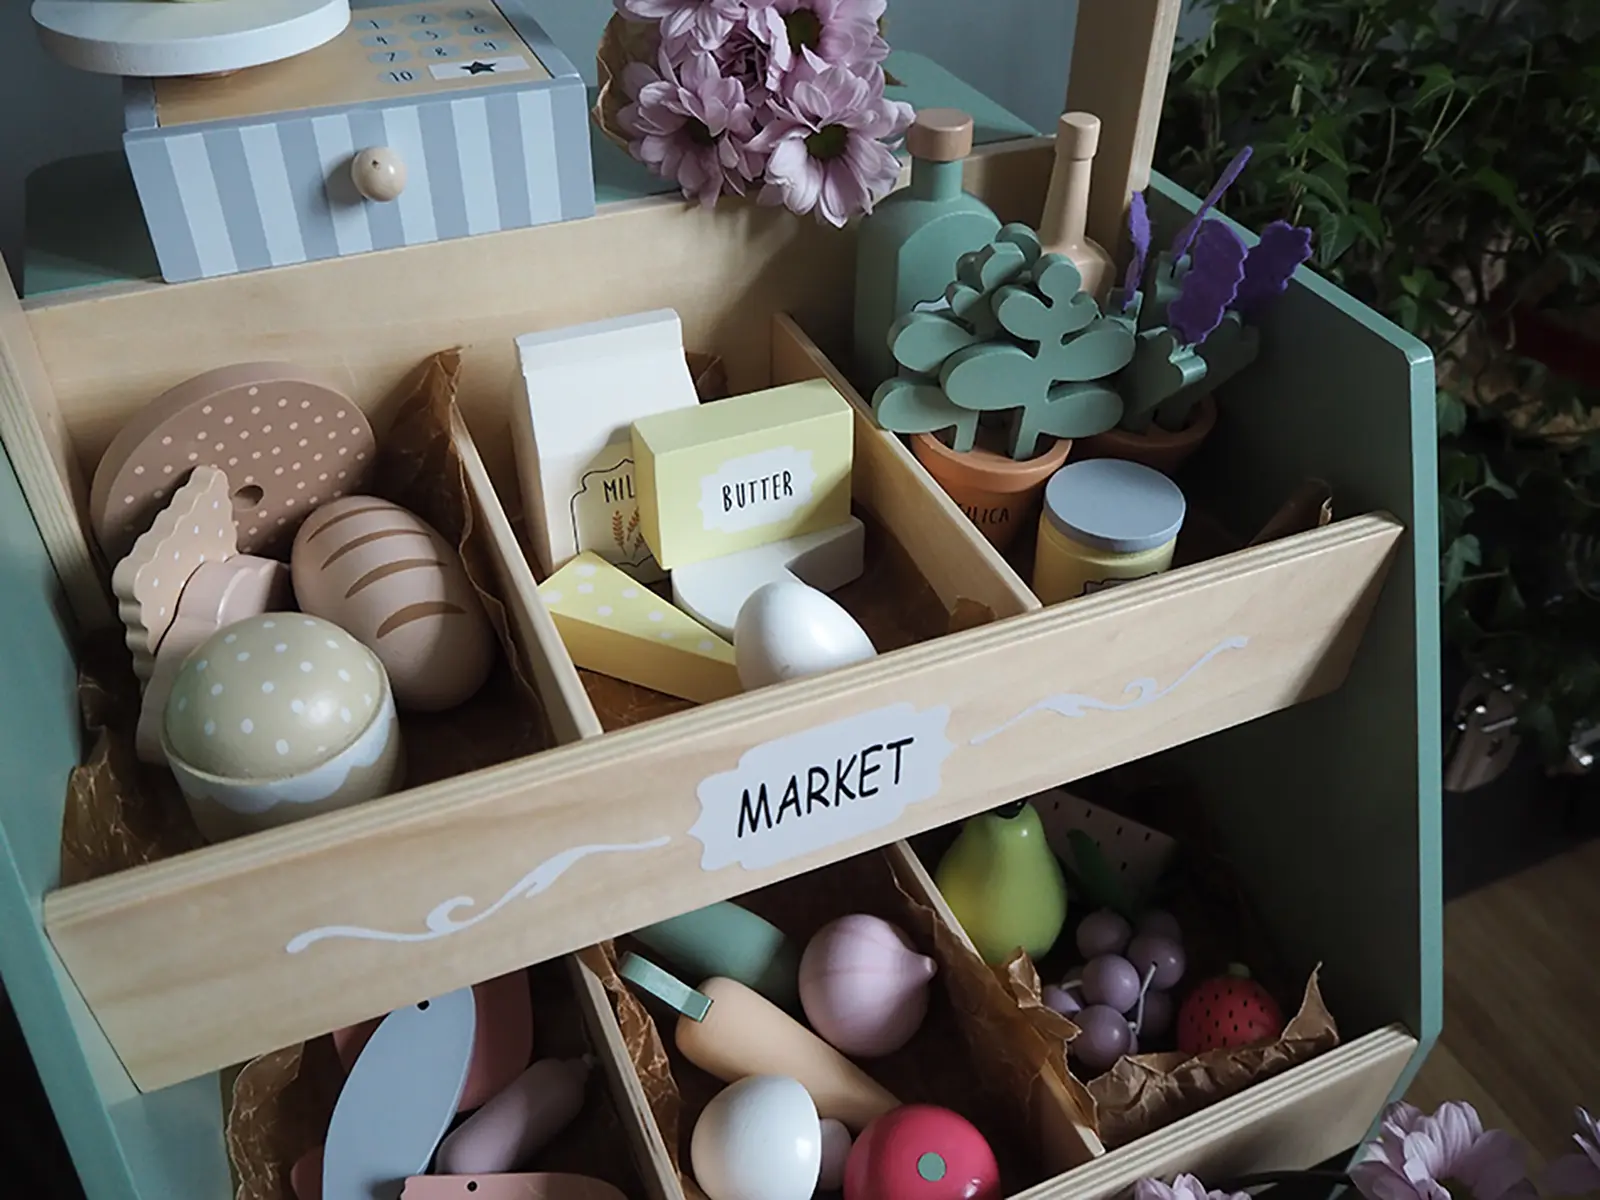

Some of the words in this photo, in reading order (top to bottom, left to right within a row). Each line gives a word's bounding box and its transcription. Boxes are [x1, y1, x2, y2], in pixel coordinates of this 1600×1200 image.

[473, 25, 485, 34] 6
[385, 52, 396, 62] 7
[389, 71, 413, 82] 10
[603, 474, 636, 504] MIL
[722, 470, 793, 512] BUTTER
[737, 737, 915, 838] MARKET
